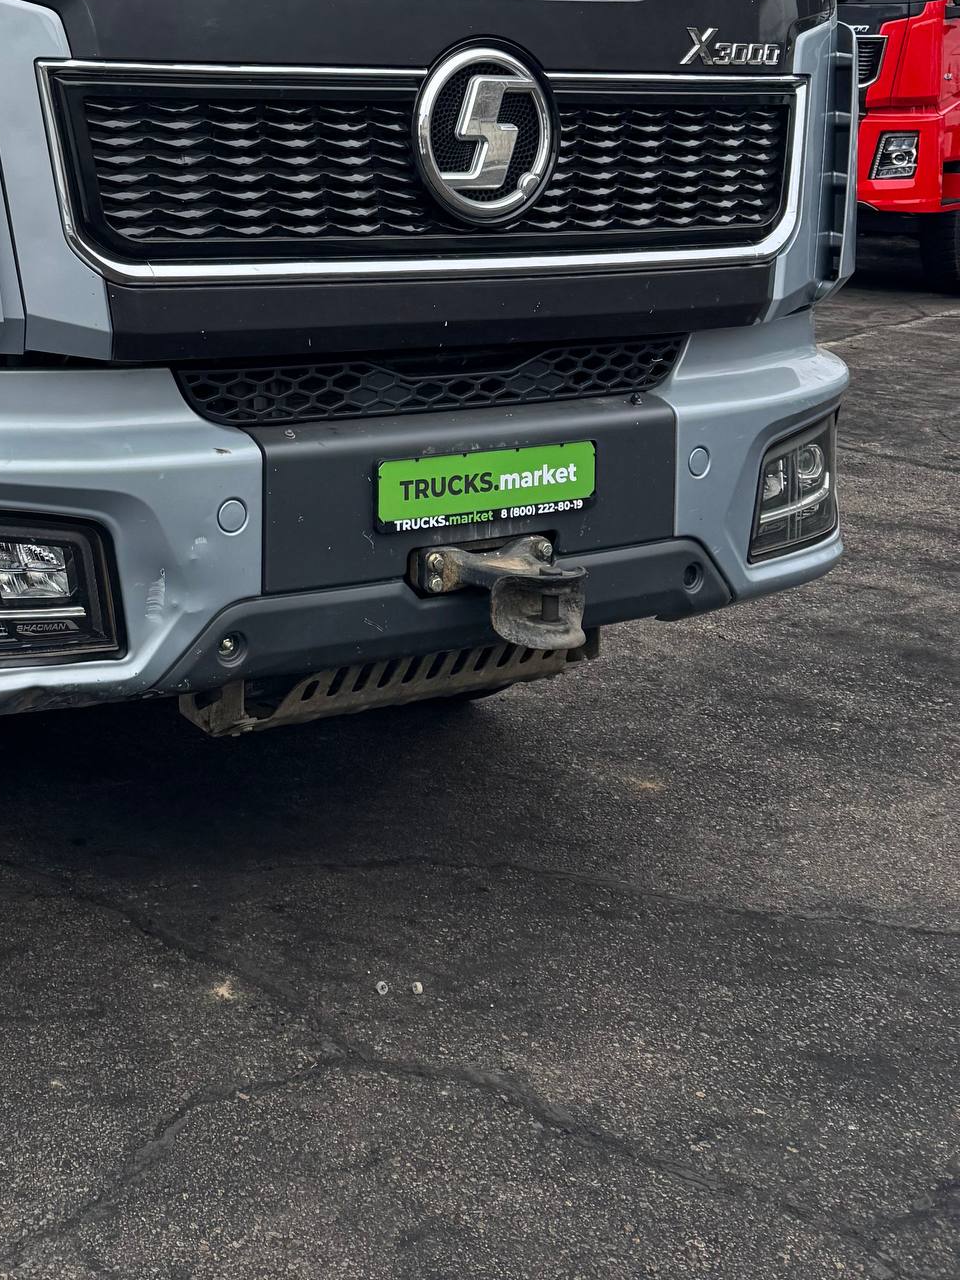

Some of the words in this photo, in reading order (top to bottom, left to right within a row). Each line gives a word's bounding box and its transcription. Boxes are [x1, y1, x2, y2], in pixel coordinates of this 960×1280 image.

[679, 26, 781, 65] X3000
[399, 463, 577, 501] TRUCKS.market
[393, 510, 494, 532] TRUCKS.market
[500, 508, 508, 519] 8
[509, 504, 536, 518] (800)
[537, 499, 584, 514] 222-80-19
[16, 623, 66, 632] SHACMAN
